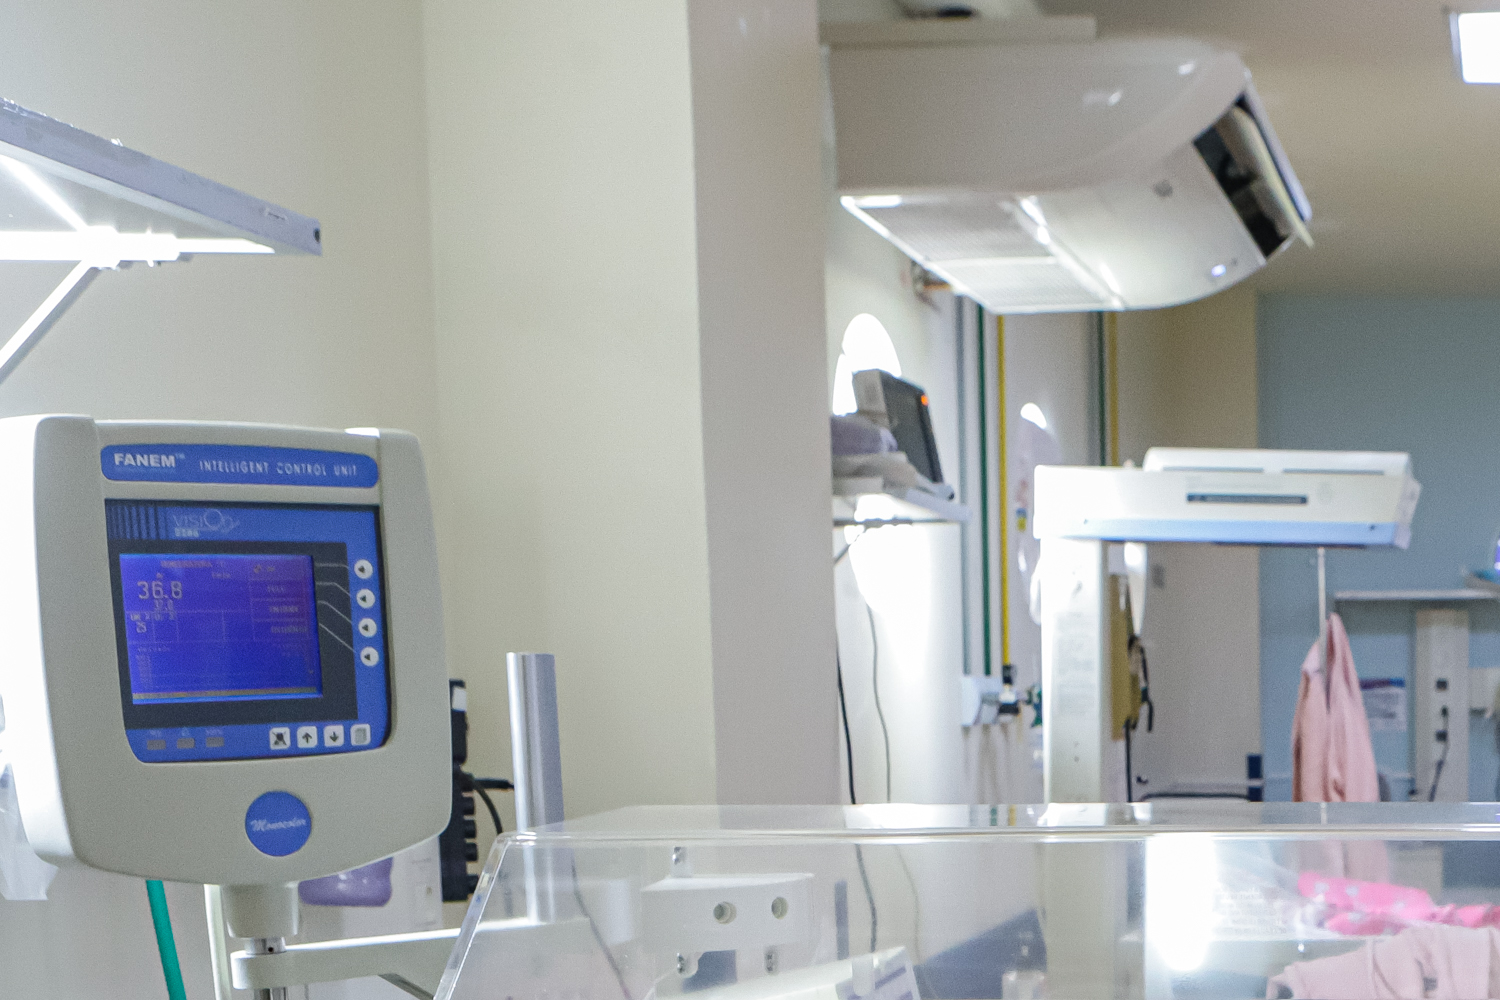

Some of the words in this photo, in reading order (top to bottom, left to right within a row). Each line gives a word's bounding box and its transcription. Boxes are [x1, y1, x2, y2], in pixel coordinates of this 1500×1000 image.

[199, 460, 269, 475] INTELLIGENT
[276, 462, 327, 476] CONTROL
[333, 464, 357, 477] UNIT
[136, 580, 184, 600] 36.8
